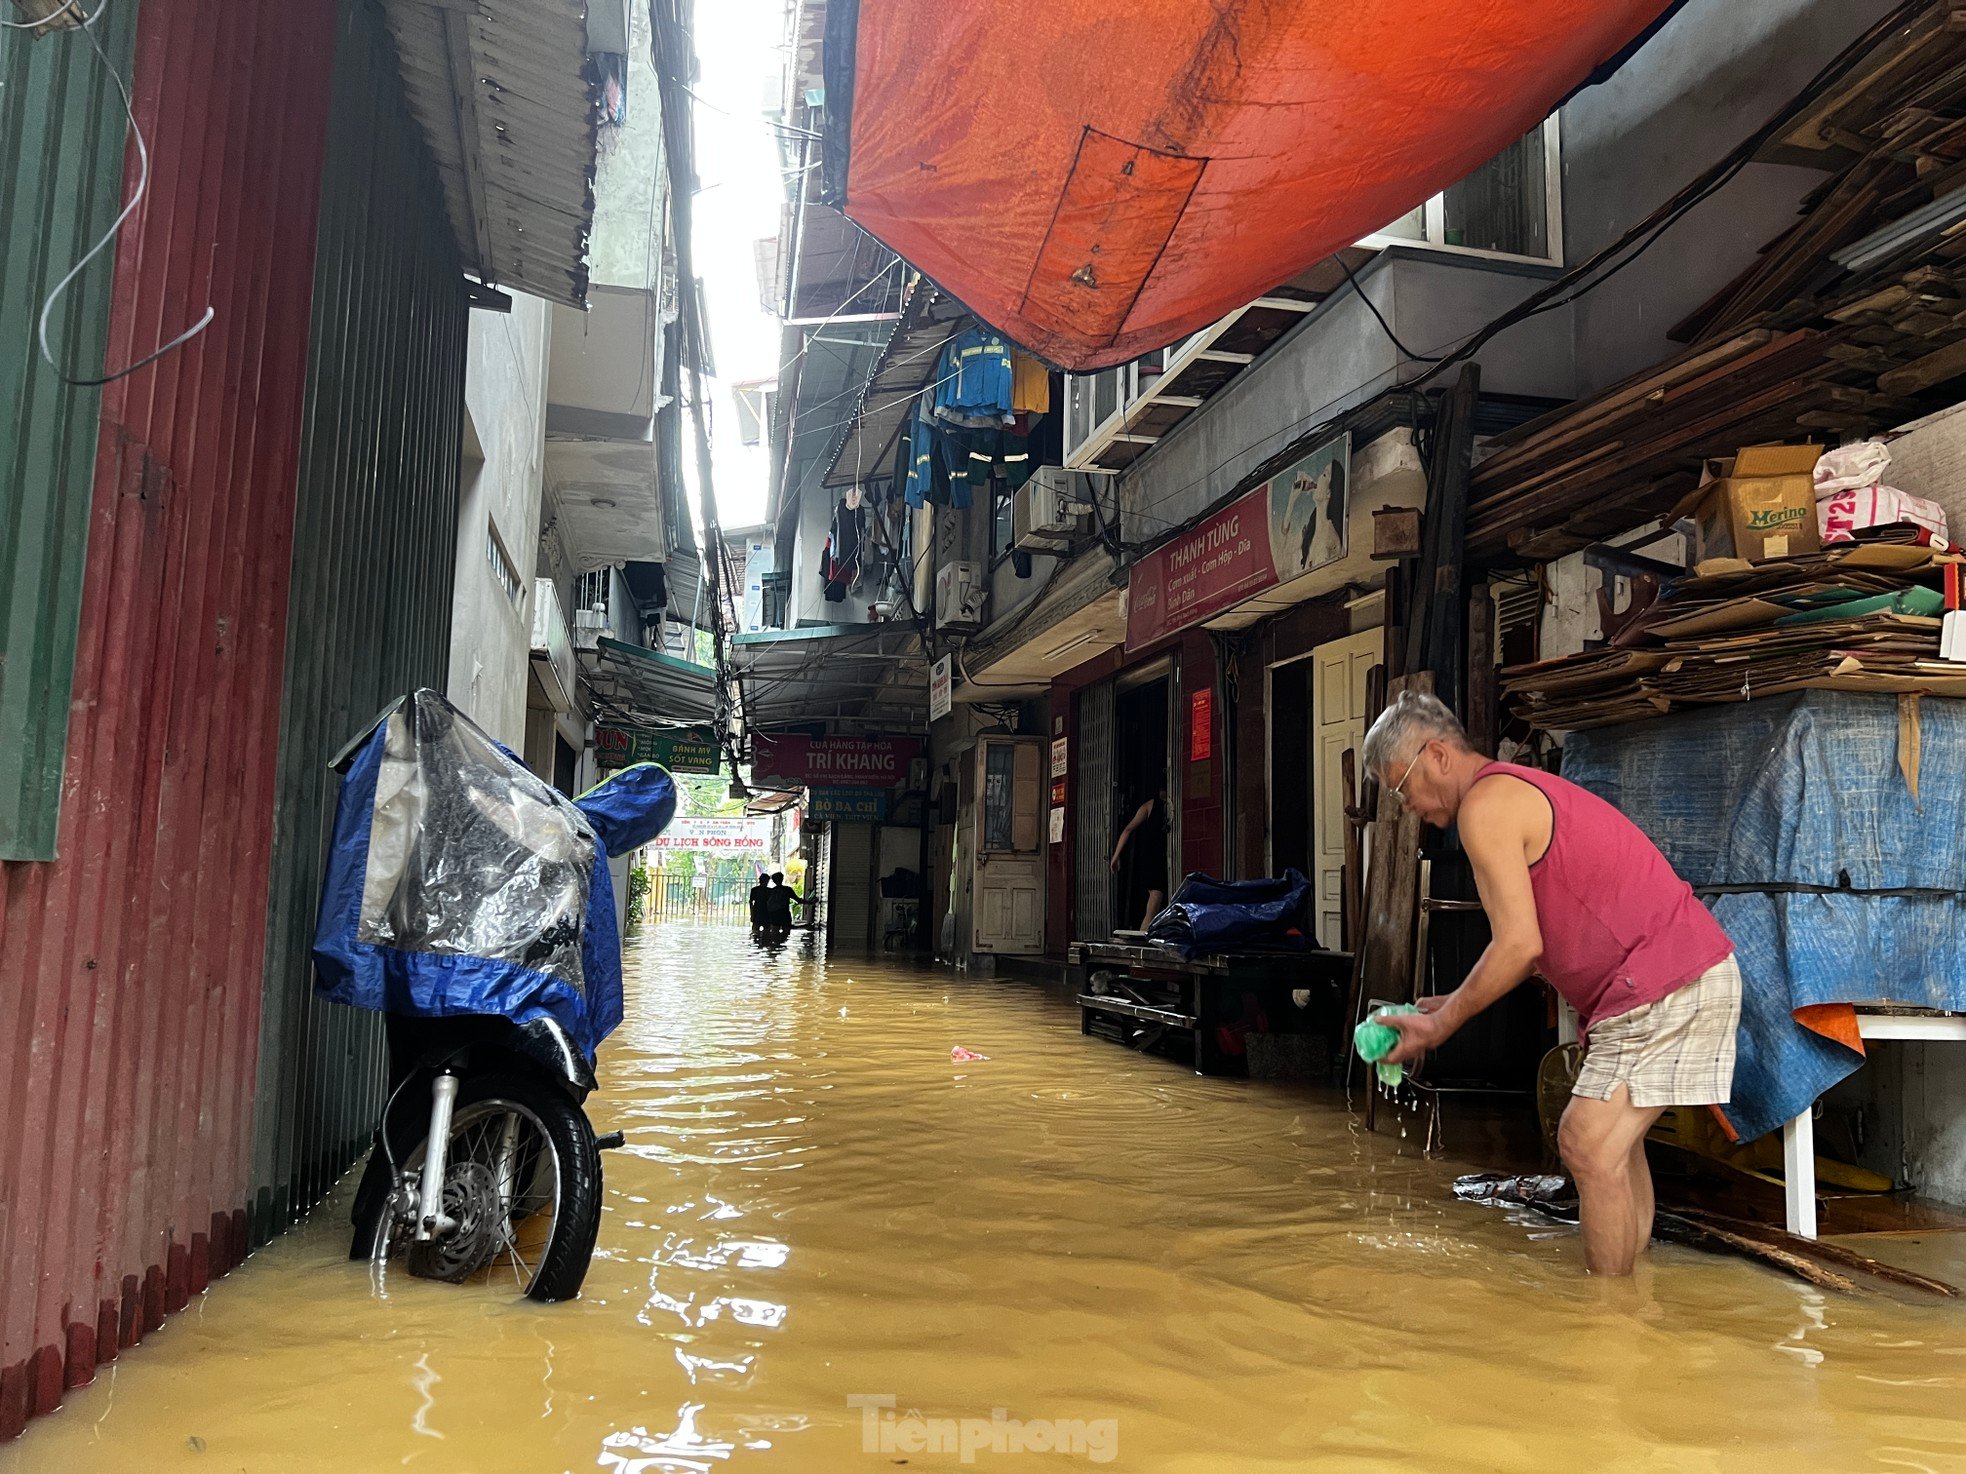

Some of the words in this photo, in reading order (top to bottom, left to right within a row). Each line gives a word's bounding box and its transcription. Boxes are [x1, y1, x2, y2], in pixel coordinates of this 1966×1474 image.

[1749, 507, 1807, 525] Merino
[1170, 535, 1205, 572] THANH
[1207, 515, 1239, 551] TÙNG
[806, 750, 832, 770] TRÍ
[836, 753, 895, 770] KHANG
[815, 798, 832, 812] BÒ
[835, 800, 852, 812] BA
[673, 838, 699, 848] LỊCH
[702, 836, 732, 847] SÔNG
